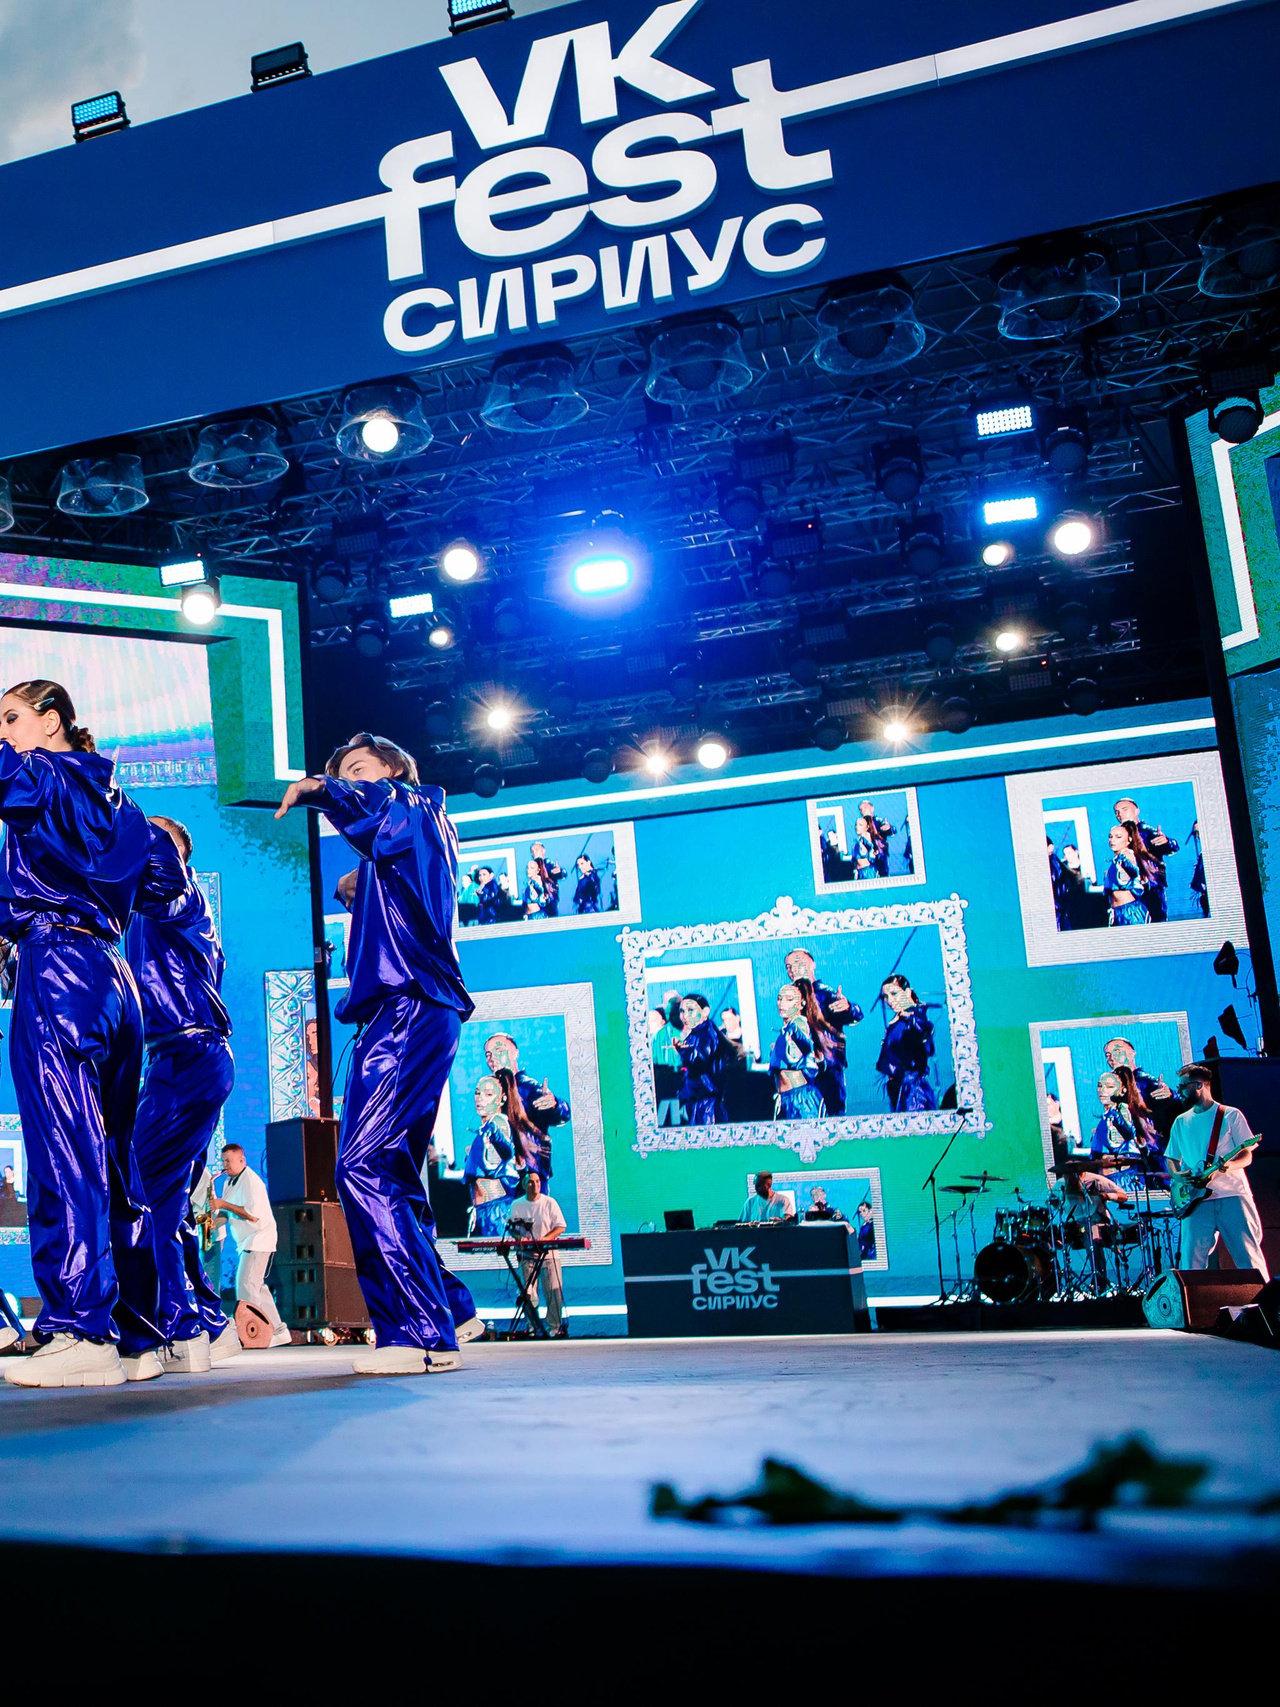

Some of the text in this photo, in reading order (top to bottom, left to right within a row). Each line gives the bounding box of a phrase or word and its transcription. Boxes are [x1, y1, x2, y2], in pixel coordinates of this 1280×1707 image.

[439, 0, 716, 152] VK
[378, 59, 834, 283] fest
[383, 203, 827, 356] СИРИУС
[691, 1263, 780, 1294] fest
[692, 1294, 778, 1311] СИРИУС
[704, 1246, 758, 1270] VK
